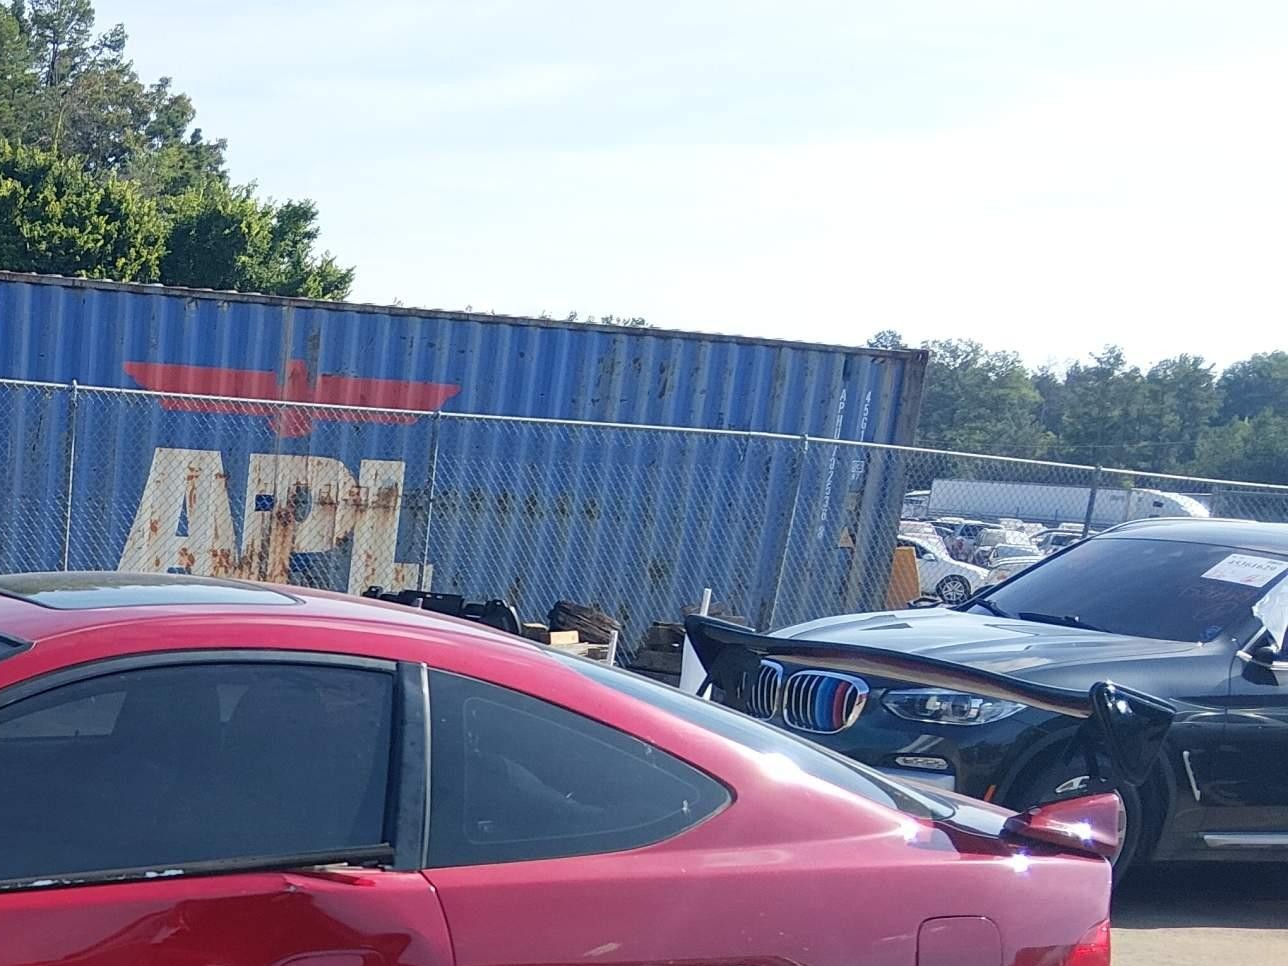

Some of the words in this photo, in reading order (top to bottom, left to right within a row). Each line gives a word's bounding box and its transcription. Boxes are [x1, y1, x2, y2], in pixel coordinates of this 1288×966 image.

[833, 388, 847, 439] APHU
[859, 391, 873, 442] 45G1
[117, 446, 433, 595] APL
